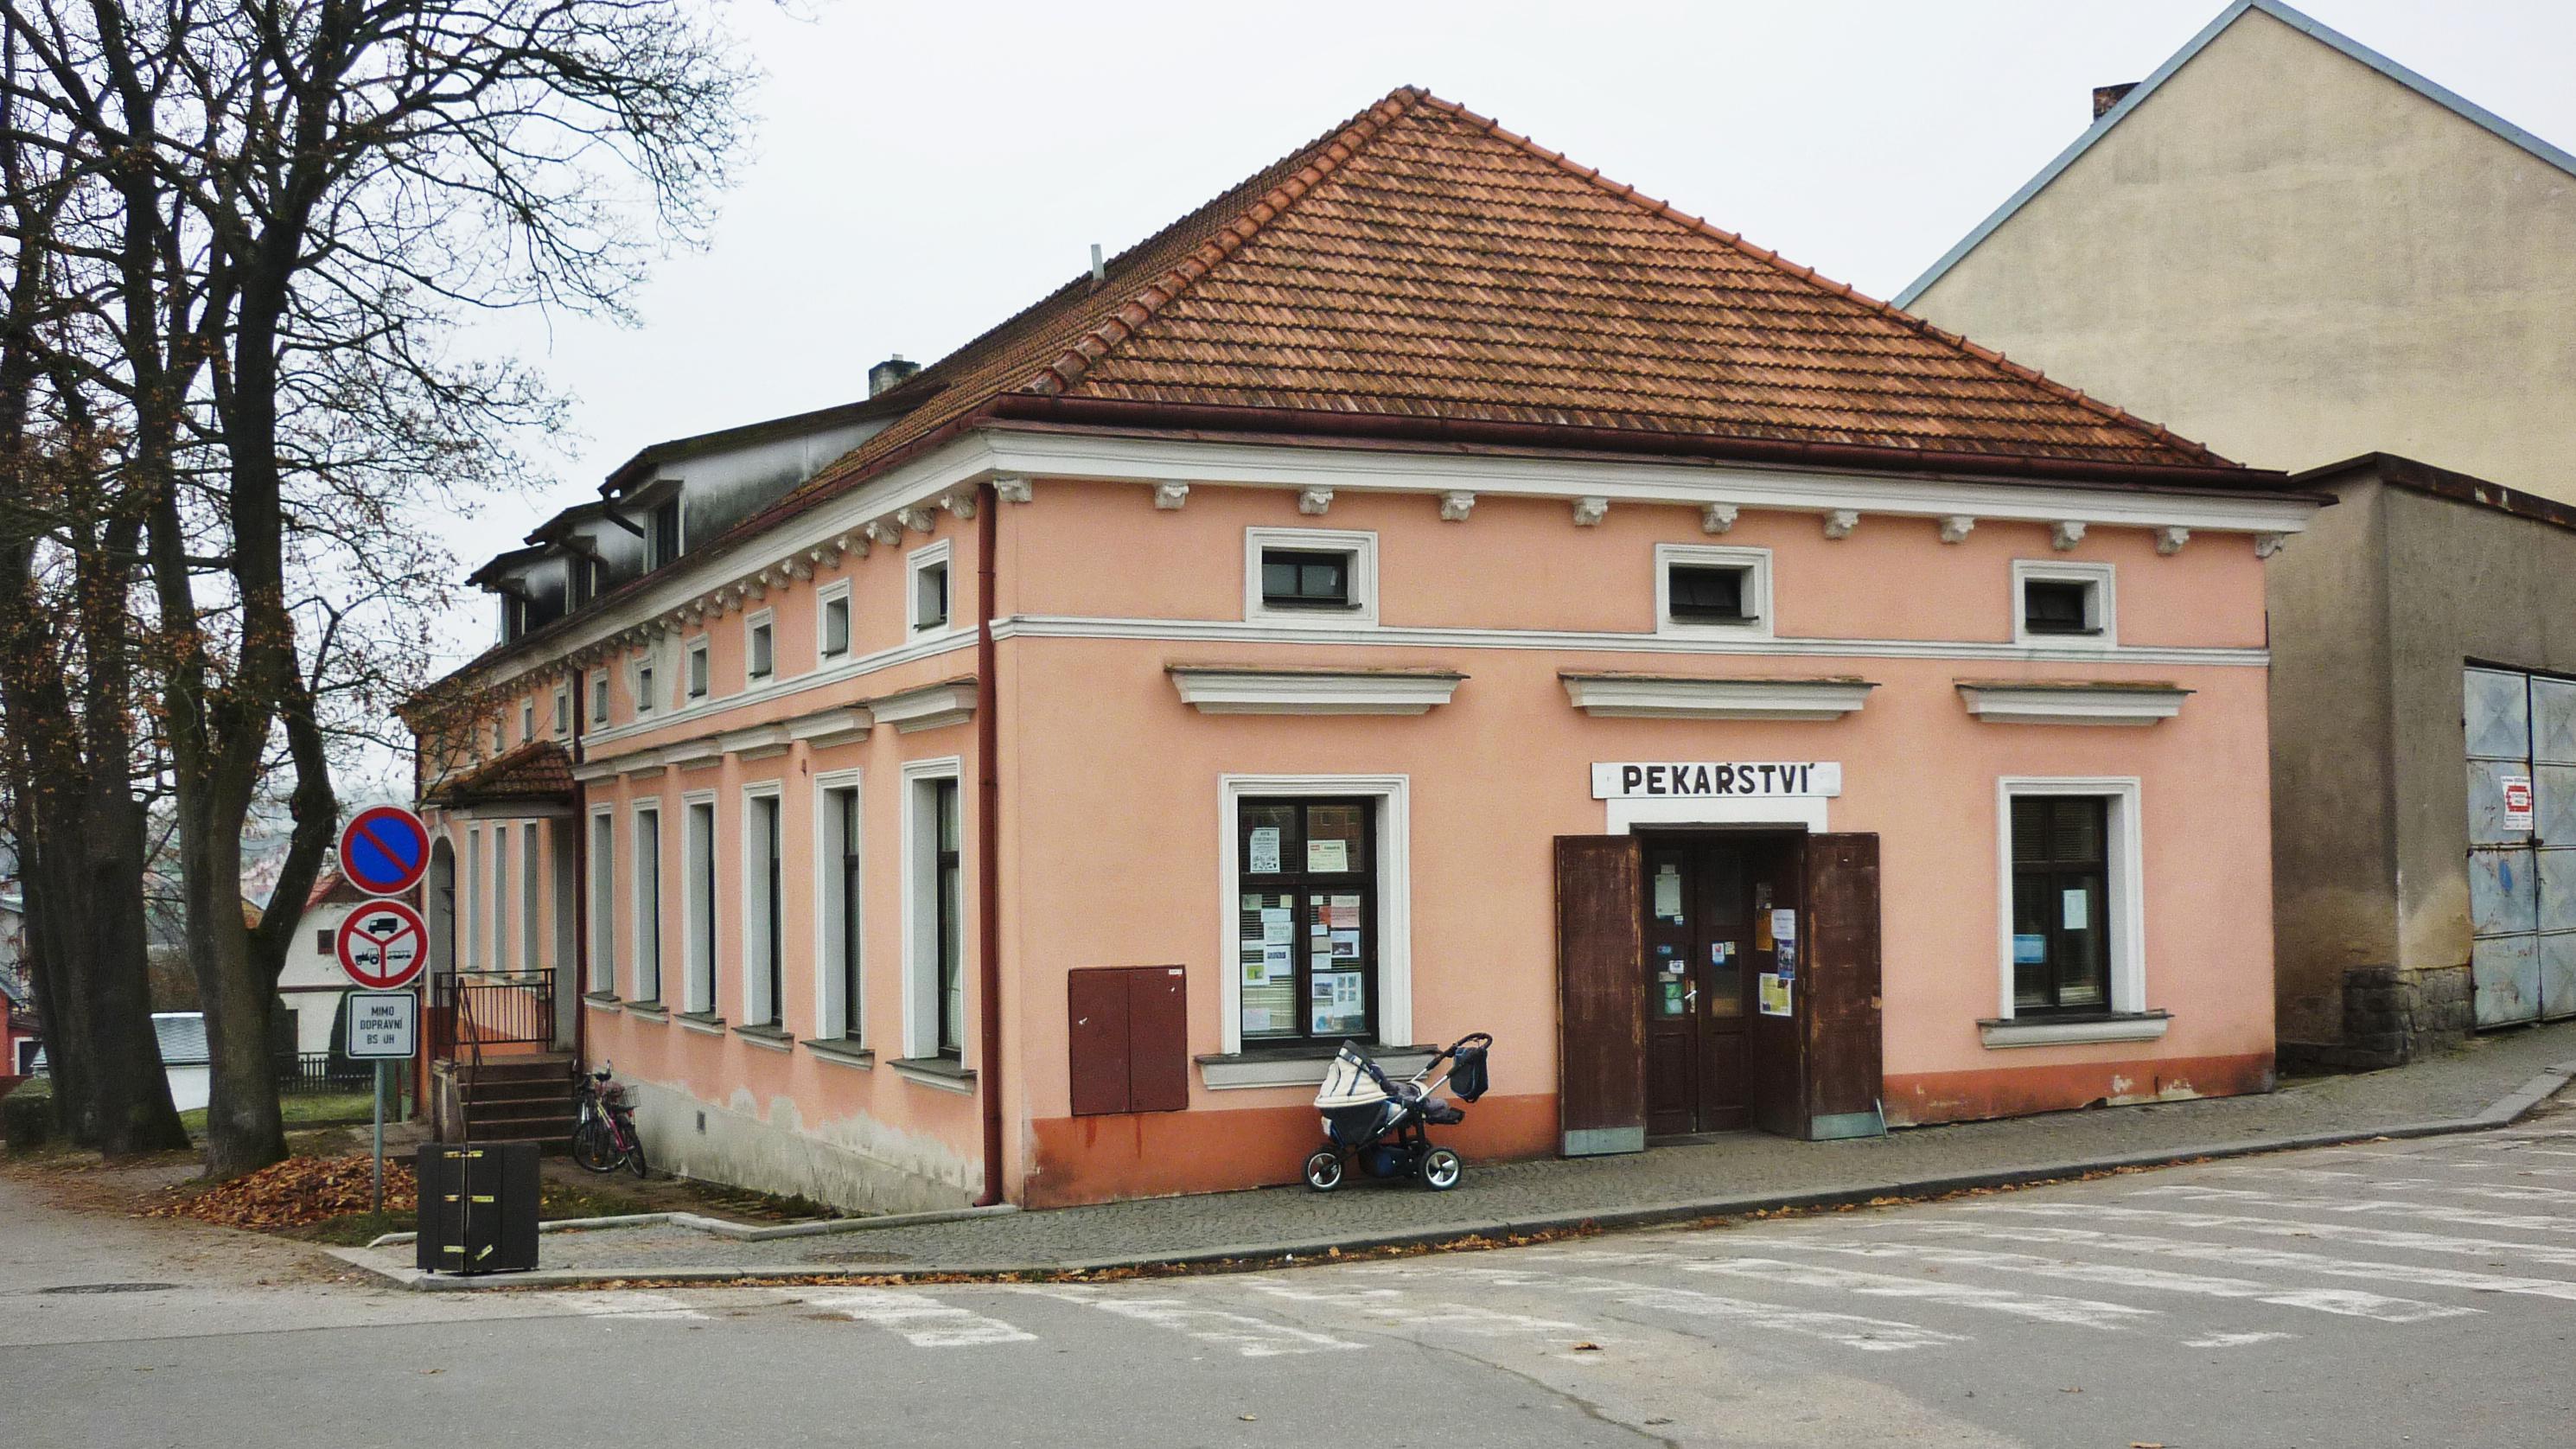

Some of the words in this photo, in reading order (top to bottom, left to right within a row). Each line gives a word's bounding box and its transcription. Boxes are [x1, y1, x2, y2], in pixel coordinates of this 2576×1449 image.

[1623, 763, 1815, 795] PEKAŘSTVÍ
[372, 1005, 394, 1016] MIMO
[360, 1018, 403, 1030] DOPRAVNÍ
